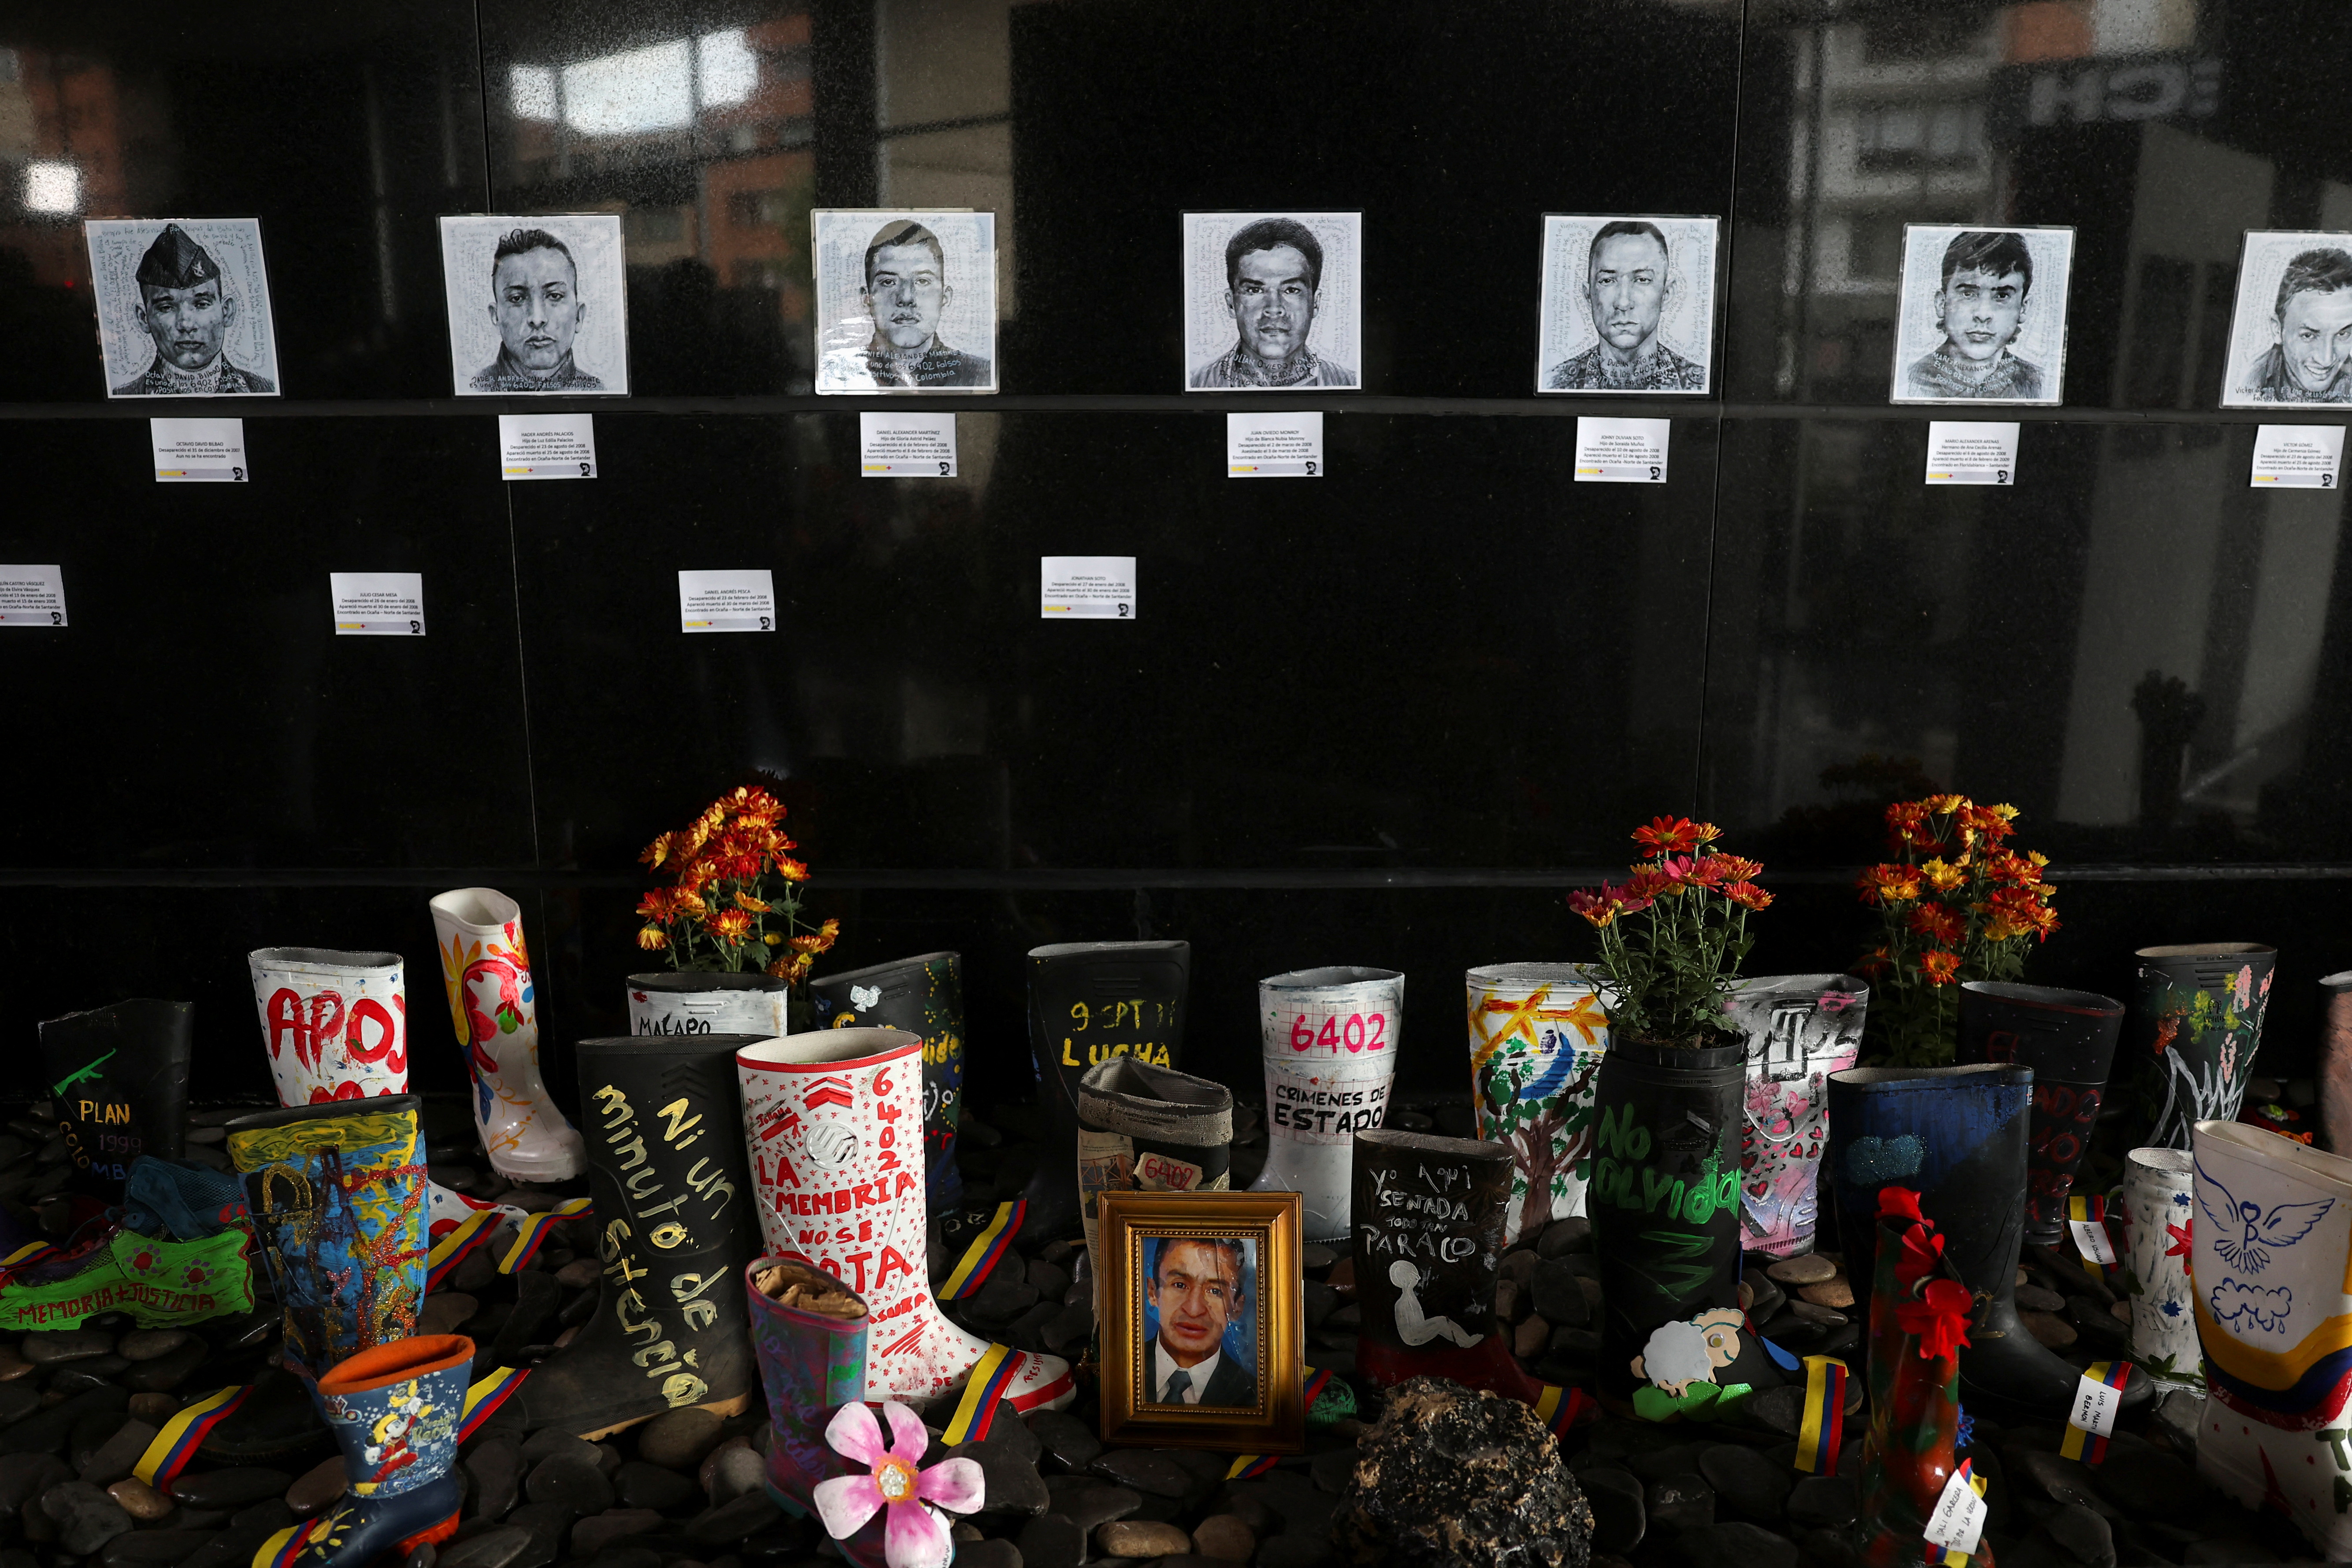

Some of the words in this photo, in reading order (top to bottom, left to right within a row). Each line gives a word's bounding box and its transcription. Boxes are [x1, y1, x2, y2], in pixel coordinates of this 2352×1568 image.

[909, 362, 935, 371] 6402
[1071, 1001, 1089, 1031] 9
[1291, 1013, 1385, 1054] 6402
[1062, 1038, 1170, 1069] LUCHA
[1276, 1085, 1363, 1107] CRIMENES
[1370, 1085, 1386, 1102] DE
[78, 1100, 130, 1125] PLAN
[873, 1066, 902, 1172] 6402
[1274, 1103, 1383, 1134] ESTADO
[99, 1134, 142, 1153] 1999
[1598, 1102, 1651, 1159] No
[757, 1154, 802, 1189] LA
[1145, 1158, 1194, 1190] 6402
[775, 1171, 917, 1216] MEMORIA
[1379, 1190, 1469, 1221] SENADA
[798, 1229, 829, 1246] NO
[835, 1220, 873, 1245] SE
[1359, 1223, 1476, 1263] PARACO
[2082, 1224, 2095, 1242] ALBEIRO
[670, 1264, 729, 1332] de
[2081, 1394, 2092, 1423] BERMON
[2098, 1391, 2107, 1406] LUIS
[1962, 1517, 1971, 1527] LA
